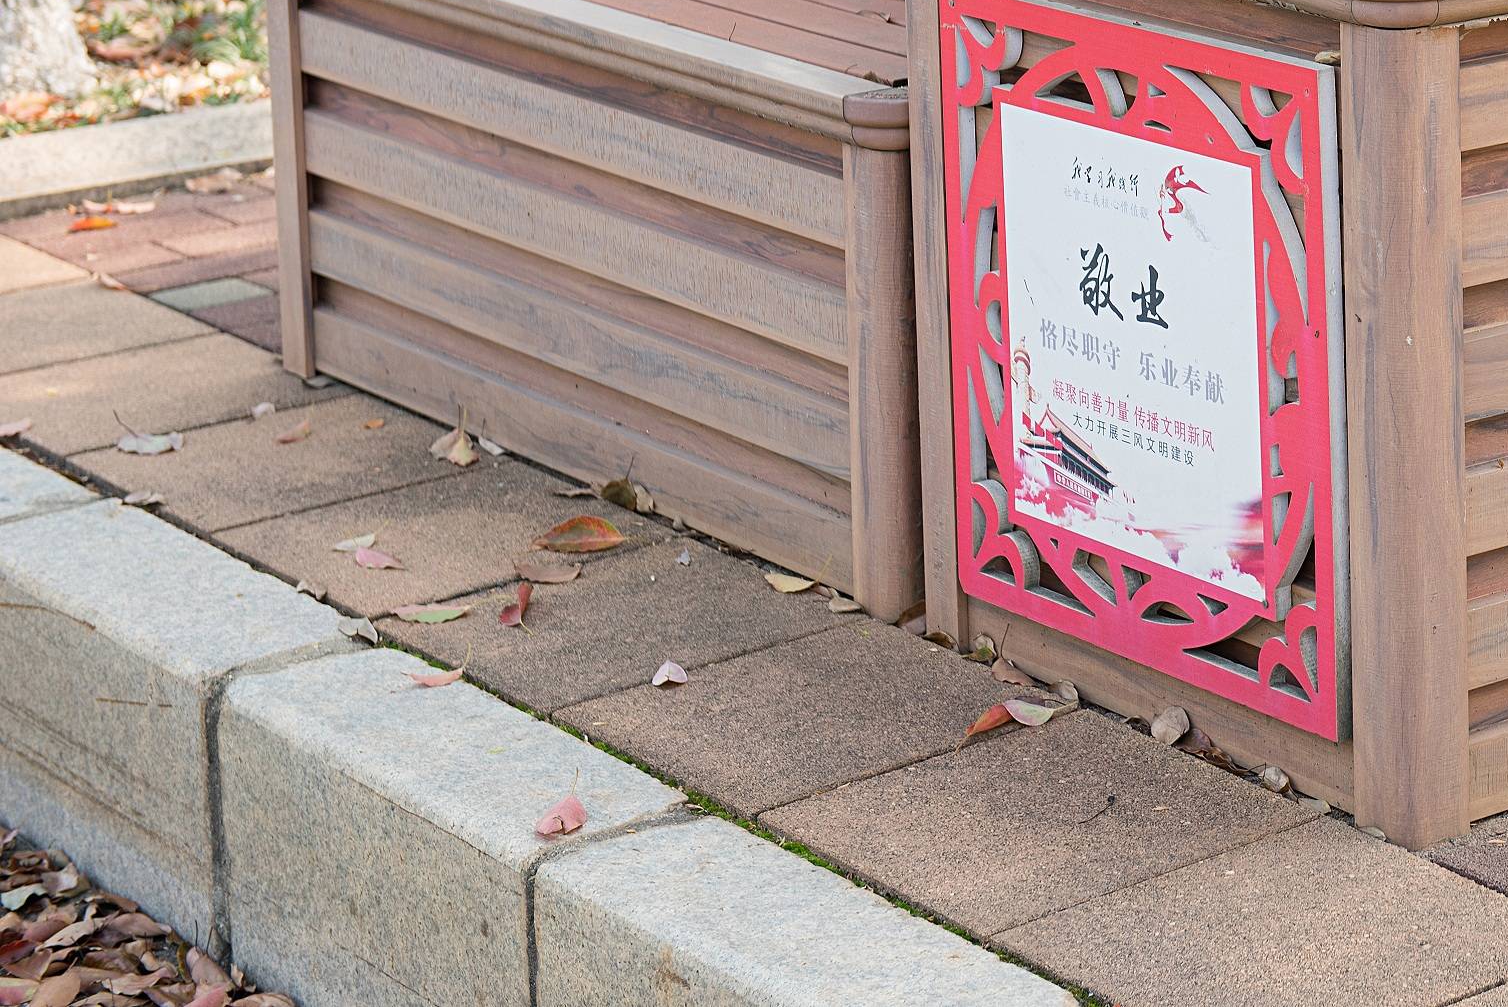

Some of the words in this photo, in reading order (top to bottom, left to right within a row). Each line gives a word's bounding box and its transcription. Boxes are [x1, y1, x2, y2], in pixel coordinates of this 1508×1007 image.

[1080, 242, 1169, 329] 敬业
[1040, 318, 1121, 371] 恪尽职守
[1139, 351, 1225, 405] 乐业奉献
[1052, 378, 1130, 423] 凝聚向善力量
[1133, 405, 1215, 453] 传播文明新风
[1073, 412, 1195, 467] 大力开展三风文明建设
